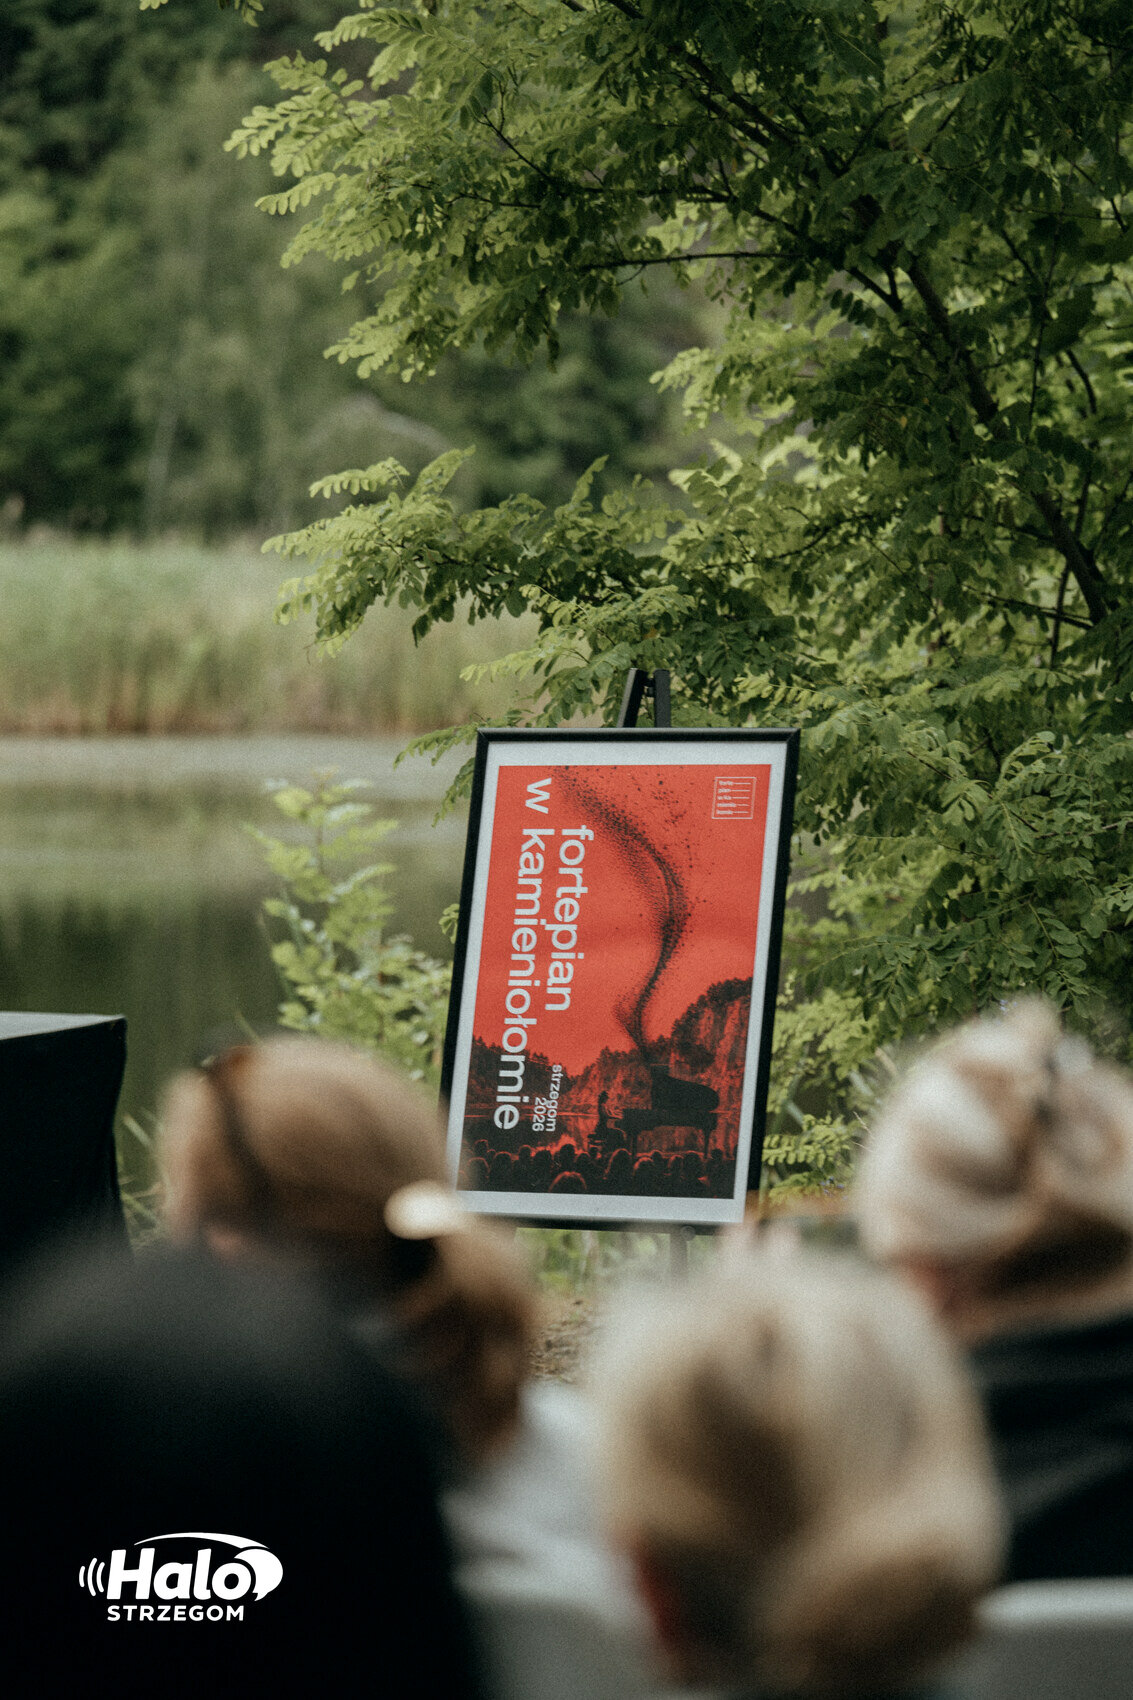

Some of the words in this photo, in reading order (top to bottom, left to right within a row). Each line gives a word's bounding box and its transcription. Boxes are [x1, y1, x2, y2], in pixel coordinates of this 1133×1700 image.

[525, 778, 552, 814] w
[545, 825, 594, 1011] fortepian
[494, 828, 555, 1130] kamieniołomie
[532, 1097, 547, 1132] 2026
[546, 1064, 563, 1132] strzegom
